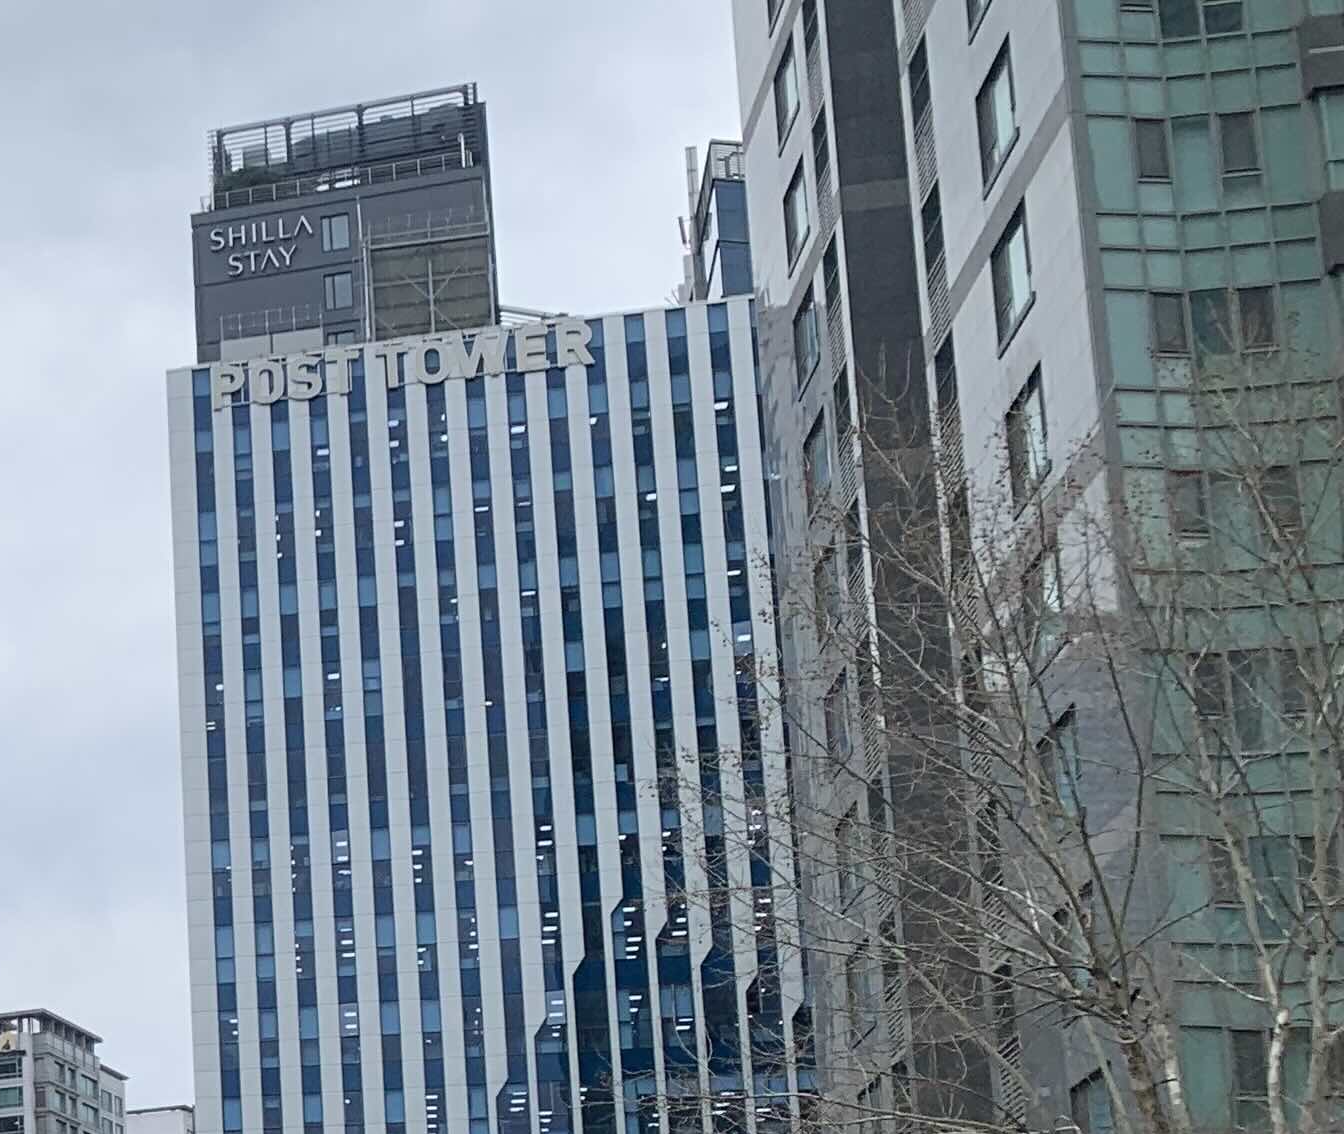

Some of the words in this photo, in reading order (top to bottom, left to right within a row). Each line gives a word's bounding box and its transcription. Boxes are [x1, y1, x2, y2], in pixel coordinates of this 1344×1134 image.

[208, 215, 313, 251] SHILLA
[228, 243, 297, 276] STAY
[213, 346, 360, 412] POST
[374, 317, 596, 390] TOWER
